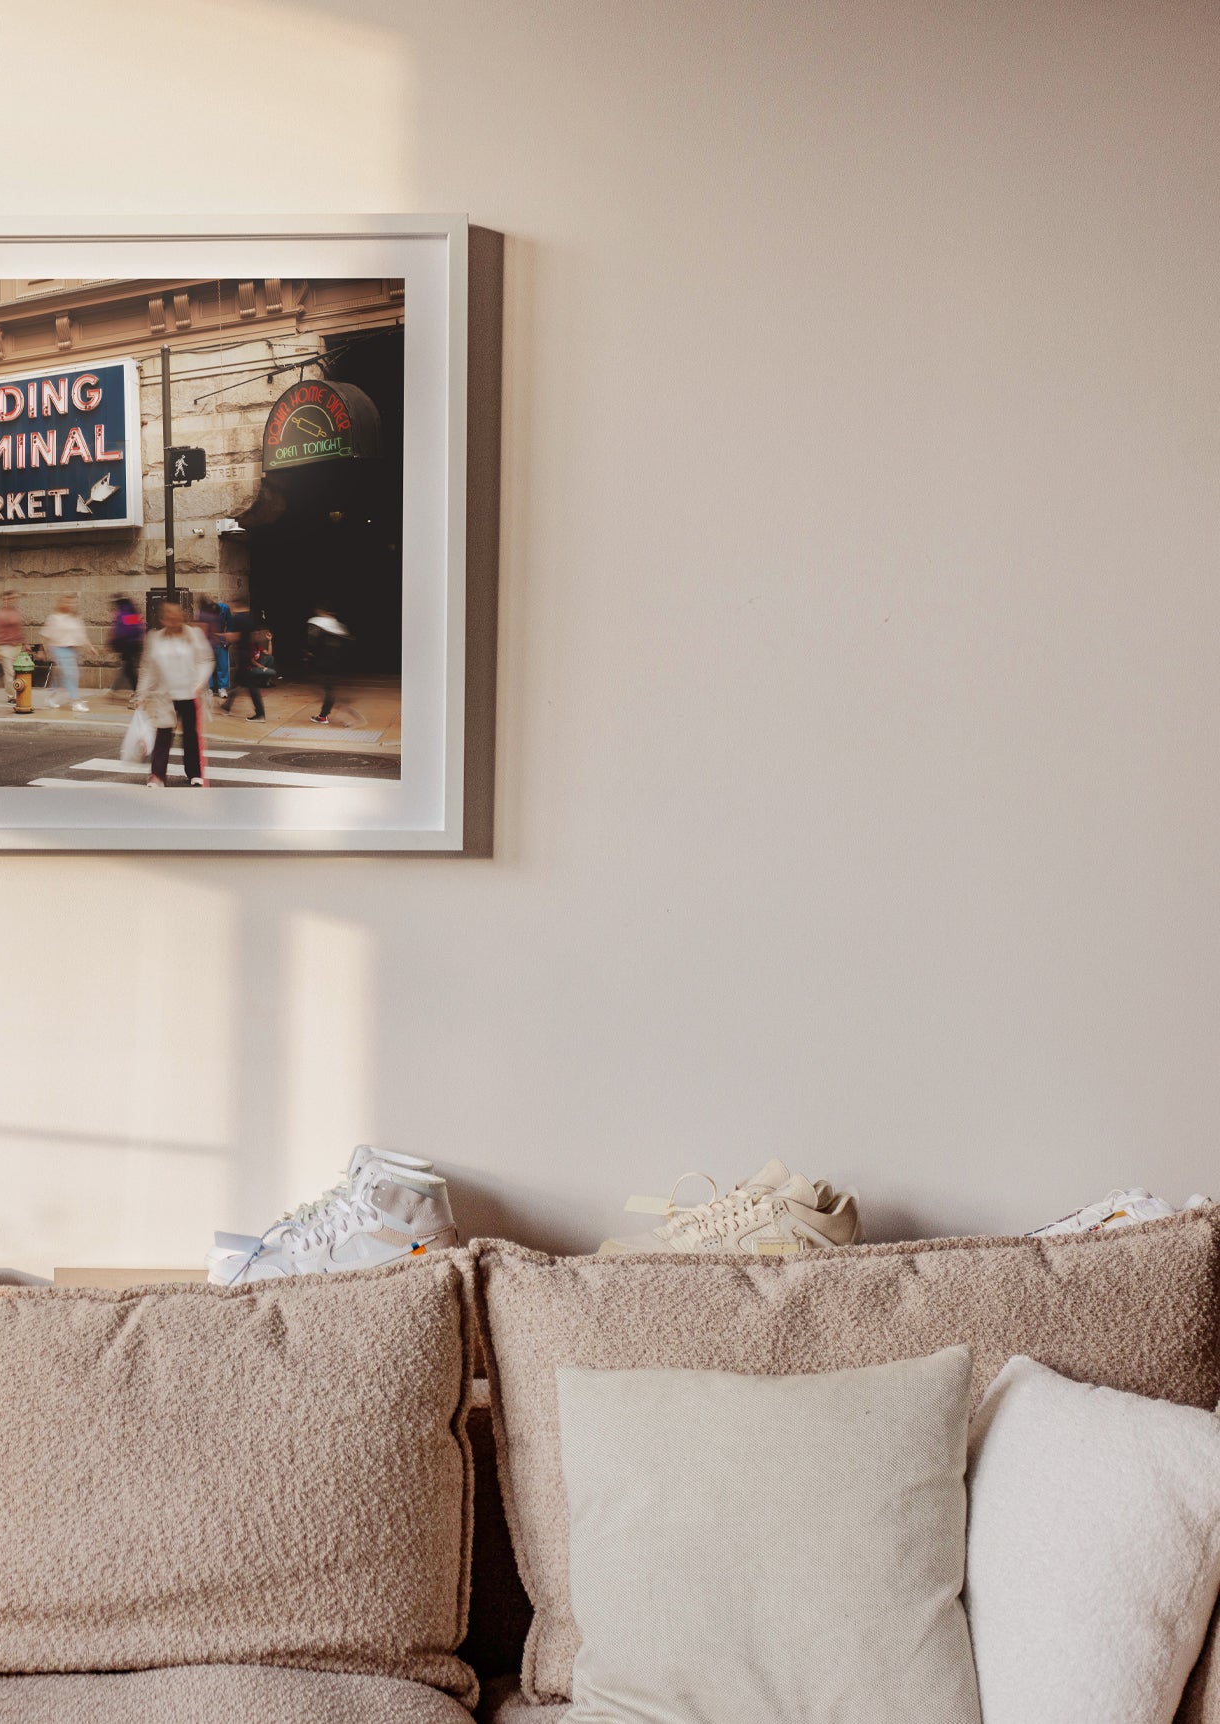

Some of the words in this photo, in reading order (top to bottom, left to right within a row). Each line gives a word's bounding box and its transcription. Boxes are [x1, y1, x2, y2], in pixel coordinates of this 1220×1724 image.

[267, 402, 291, 445] DOWN
[290, 385, 327, 408] HOME
[325, 393, 351, 433] DINER
[275, 445, 298, 460] OPEN
[303, 437, 343, 455] TONIGHT
